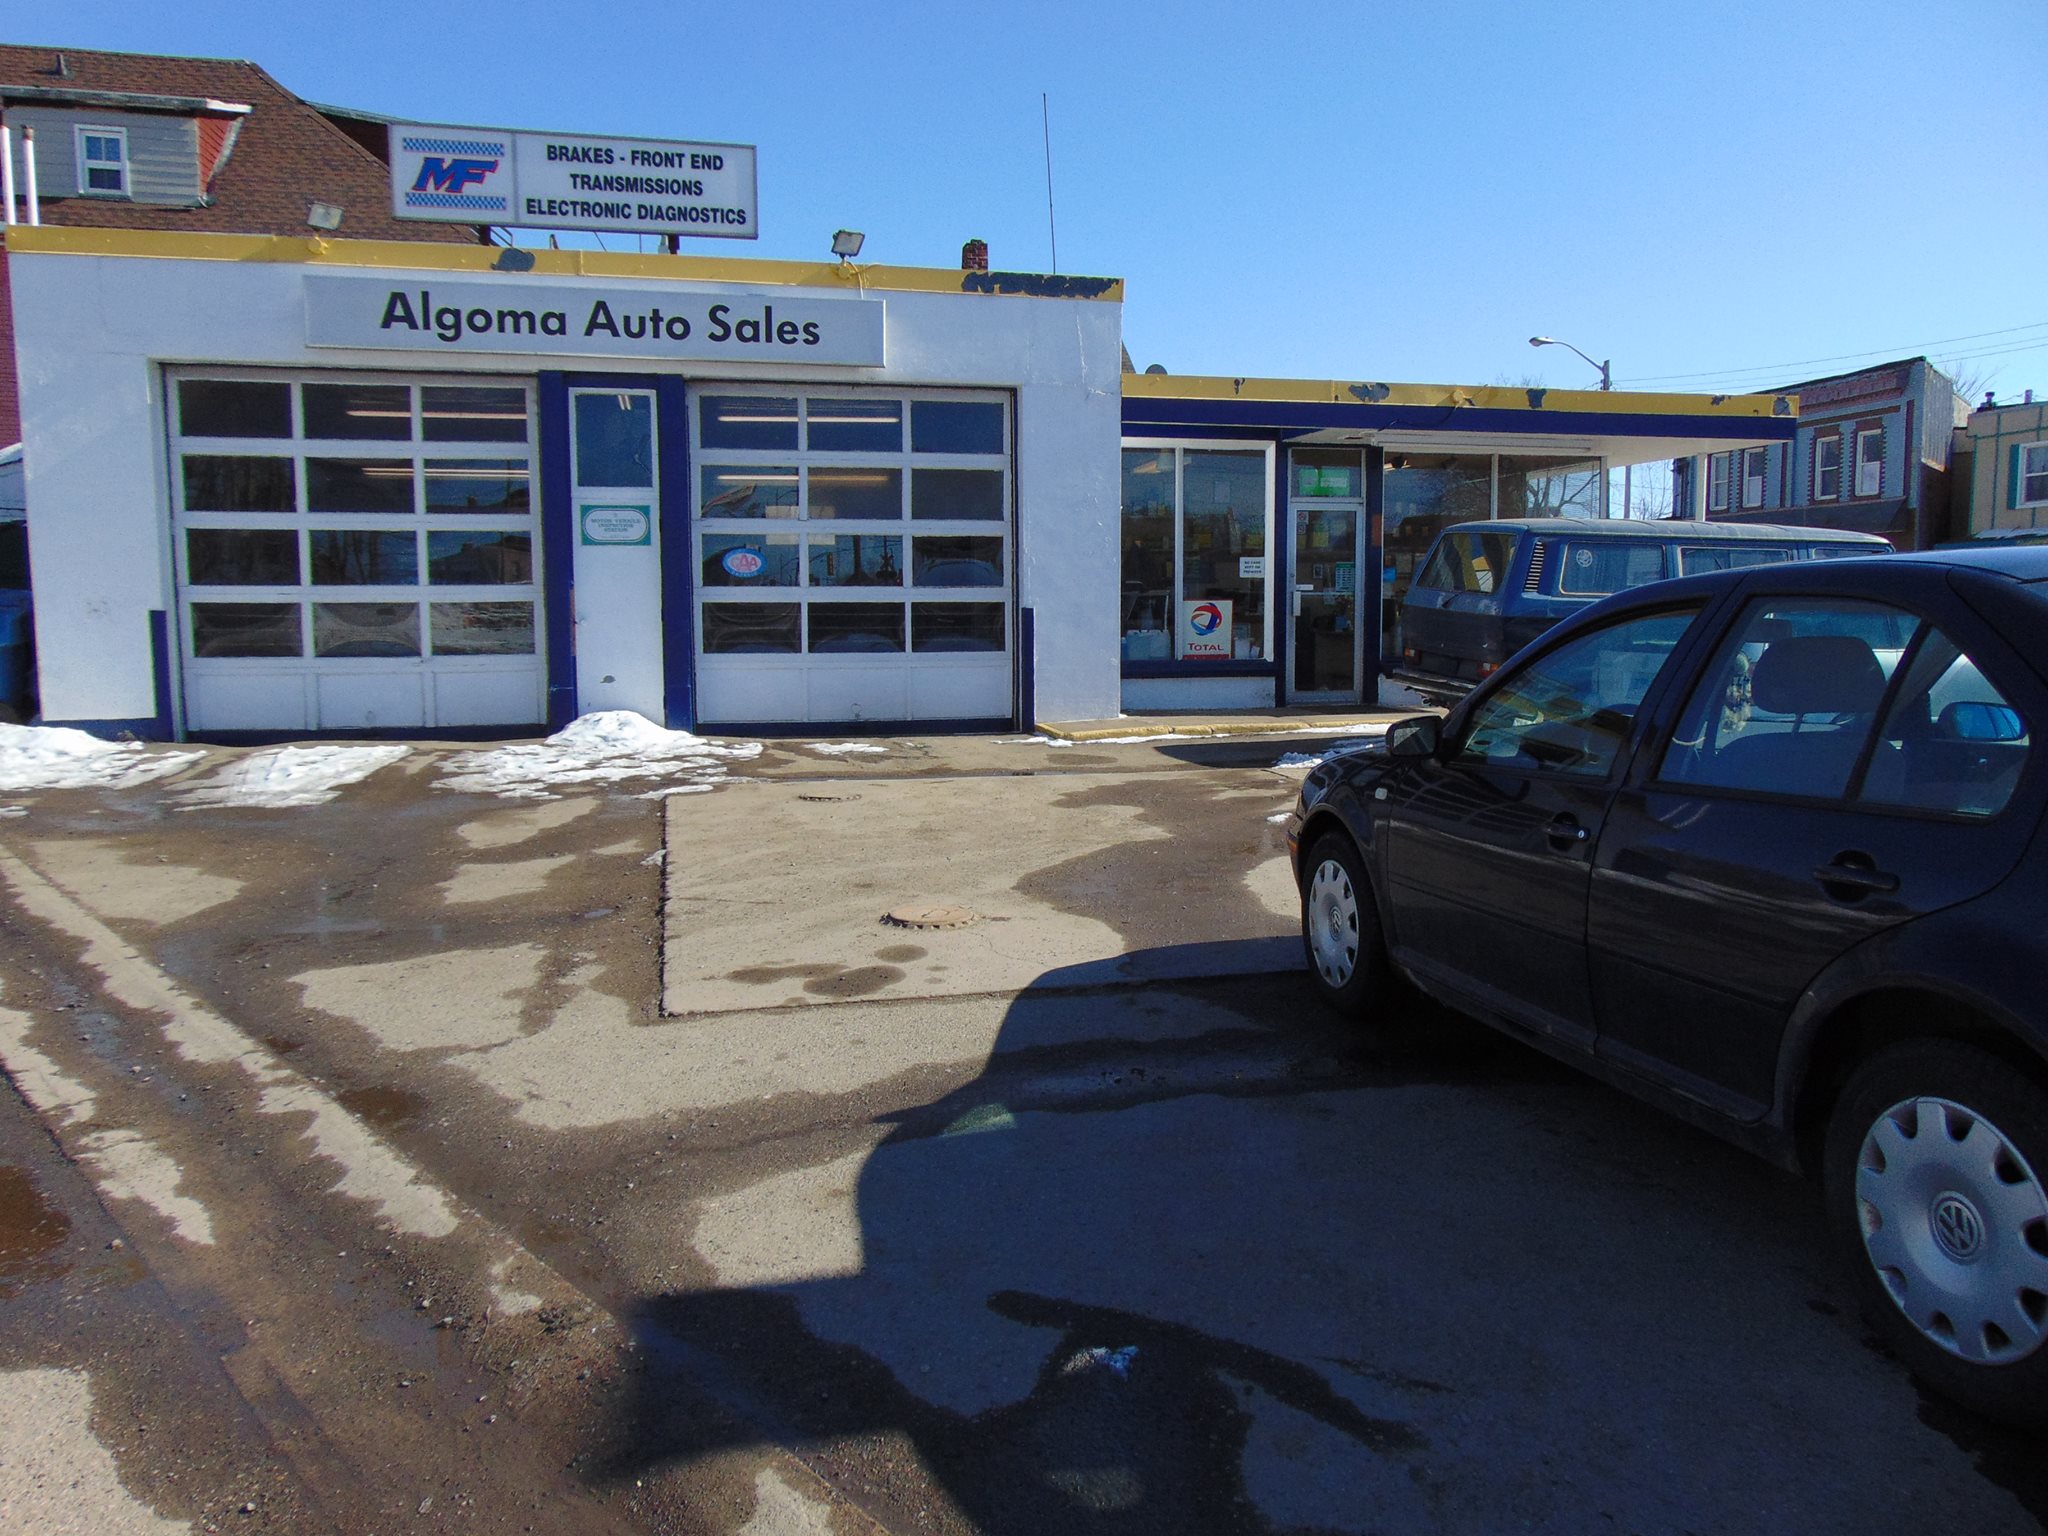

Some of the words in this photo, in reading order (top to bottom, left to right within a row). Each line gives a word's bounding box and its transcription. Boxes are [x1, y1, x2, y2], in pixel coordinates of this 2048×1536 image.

[546, 144, 615, 165] BRAKES
[631, 150, 686, 169] FRONT
[690, 154, 724, 171] END
[412, 157, 499, 193] MF
[569, 172, 704, 197] TRANSMISSIONS
[526, 198, 632, 220] ELECTRONIC
[637, 203, 747, 225] DIAGNOSTICS
[381, 290, 567, 342] Algoma
[583, 300, 692, 341] Auto
[707, 304, 821, 346] Sales
[1187, 642, 1225, 652] TOTAL
